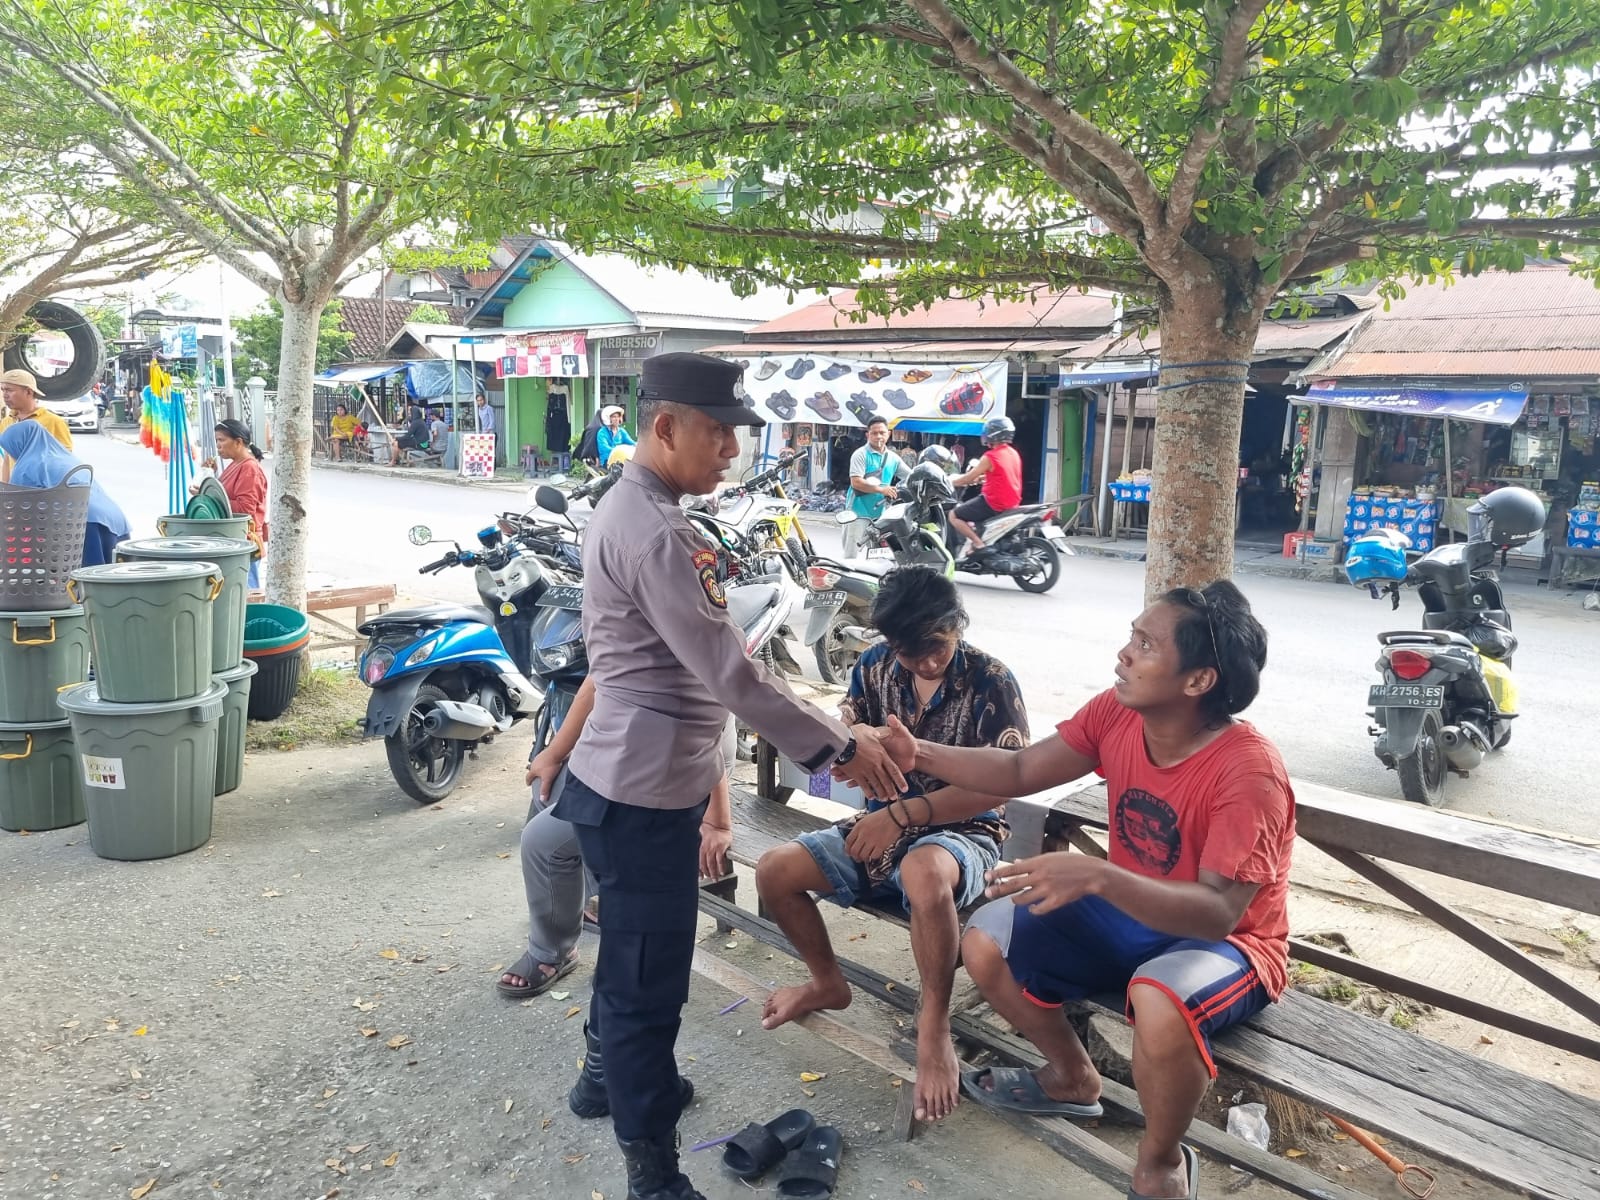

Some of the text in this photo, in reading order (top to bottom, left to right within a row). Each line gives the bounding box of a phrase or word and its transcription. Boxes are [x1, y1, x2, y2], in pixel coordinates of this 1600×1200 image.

[600, 336, 662, 348] ARBERSHO
[1371, 686, 1441, 697] KH 2756 ES
